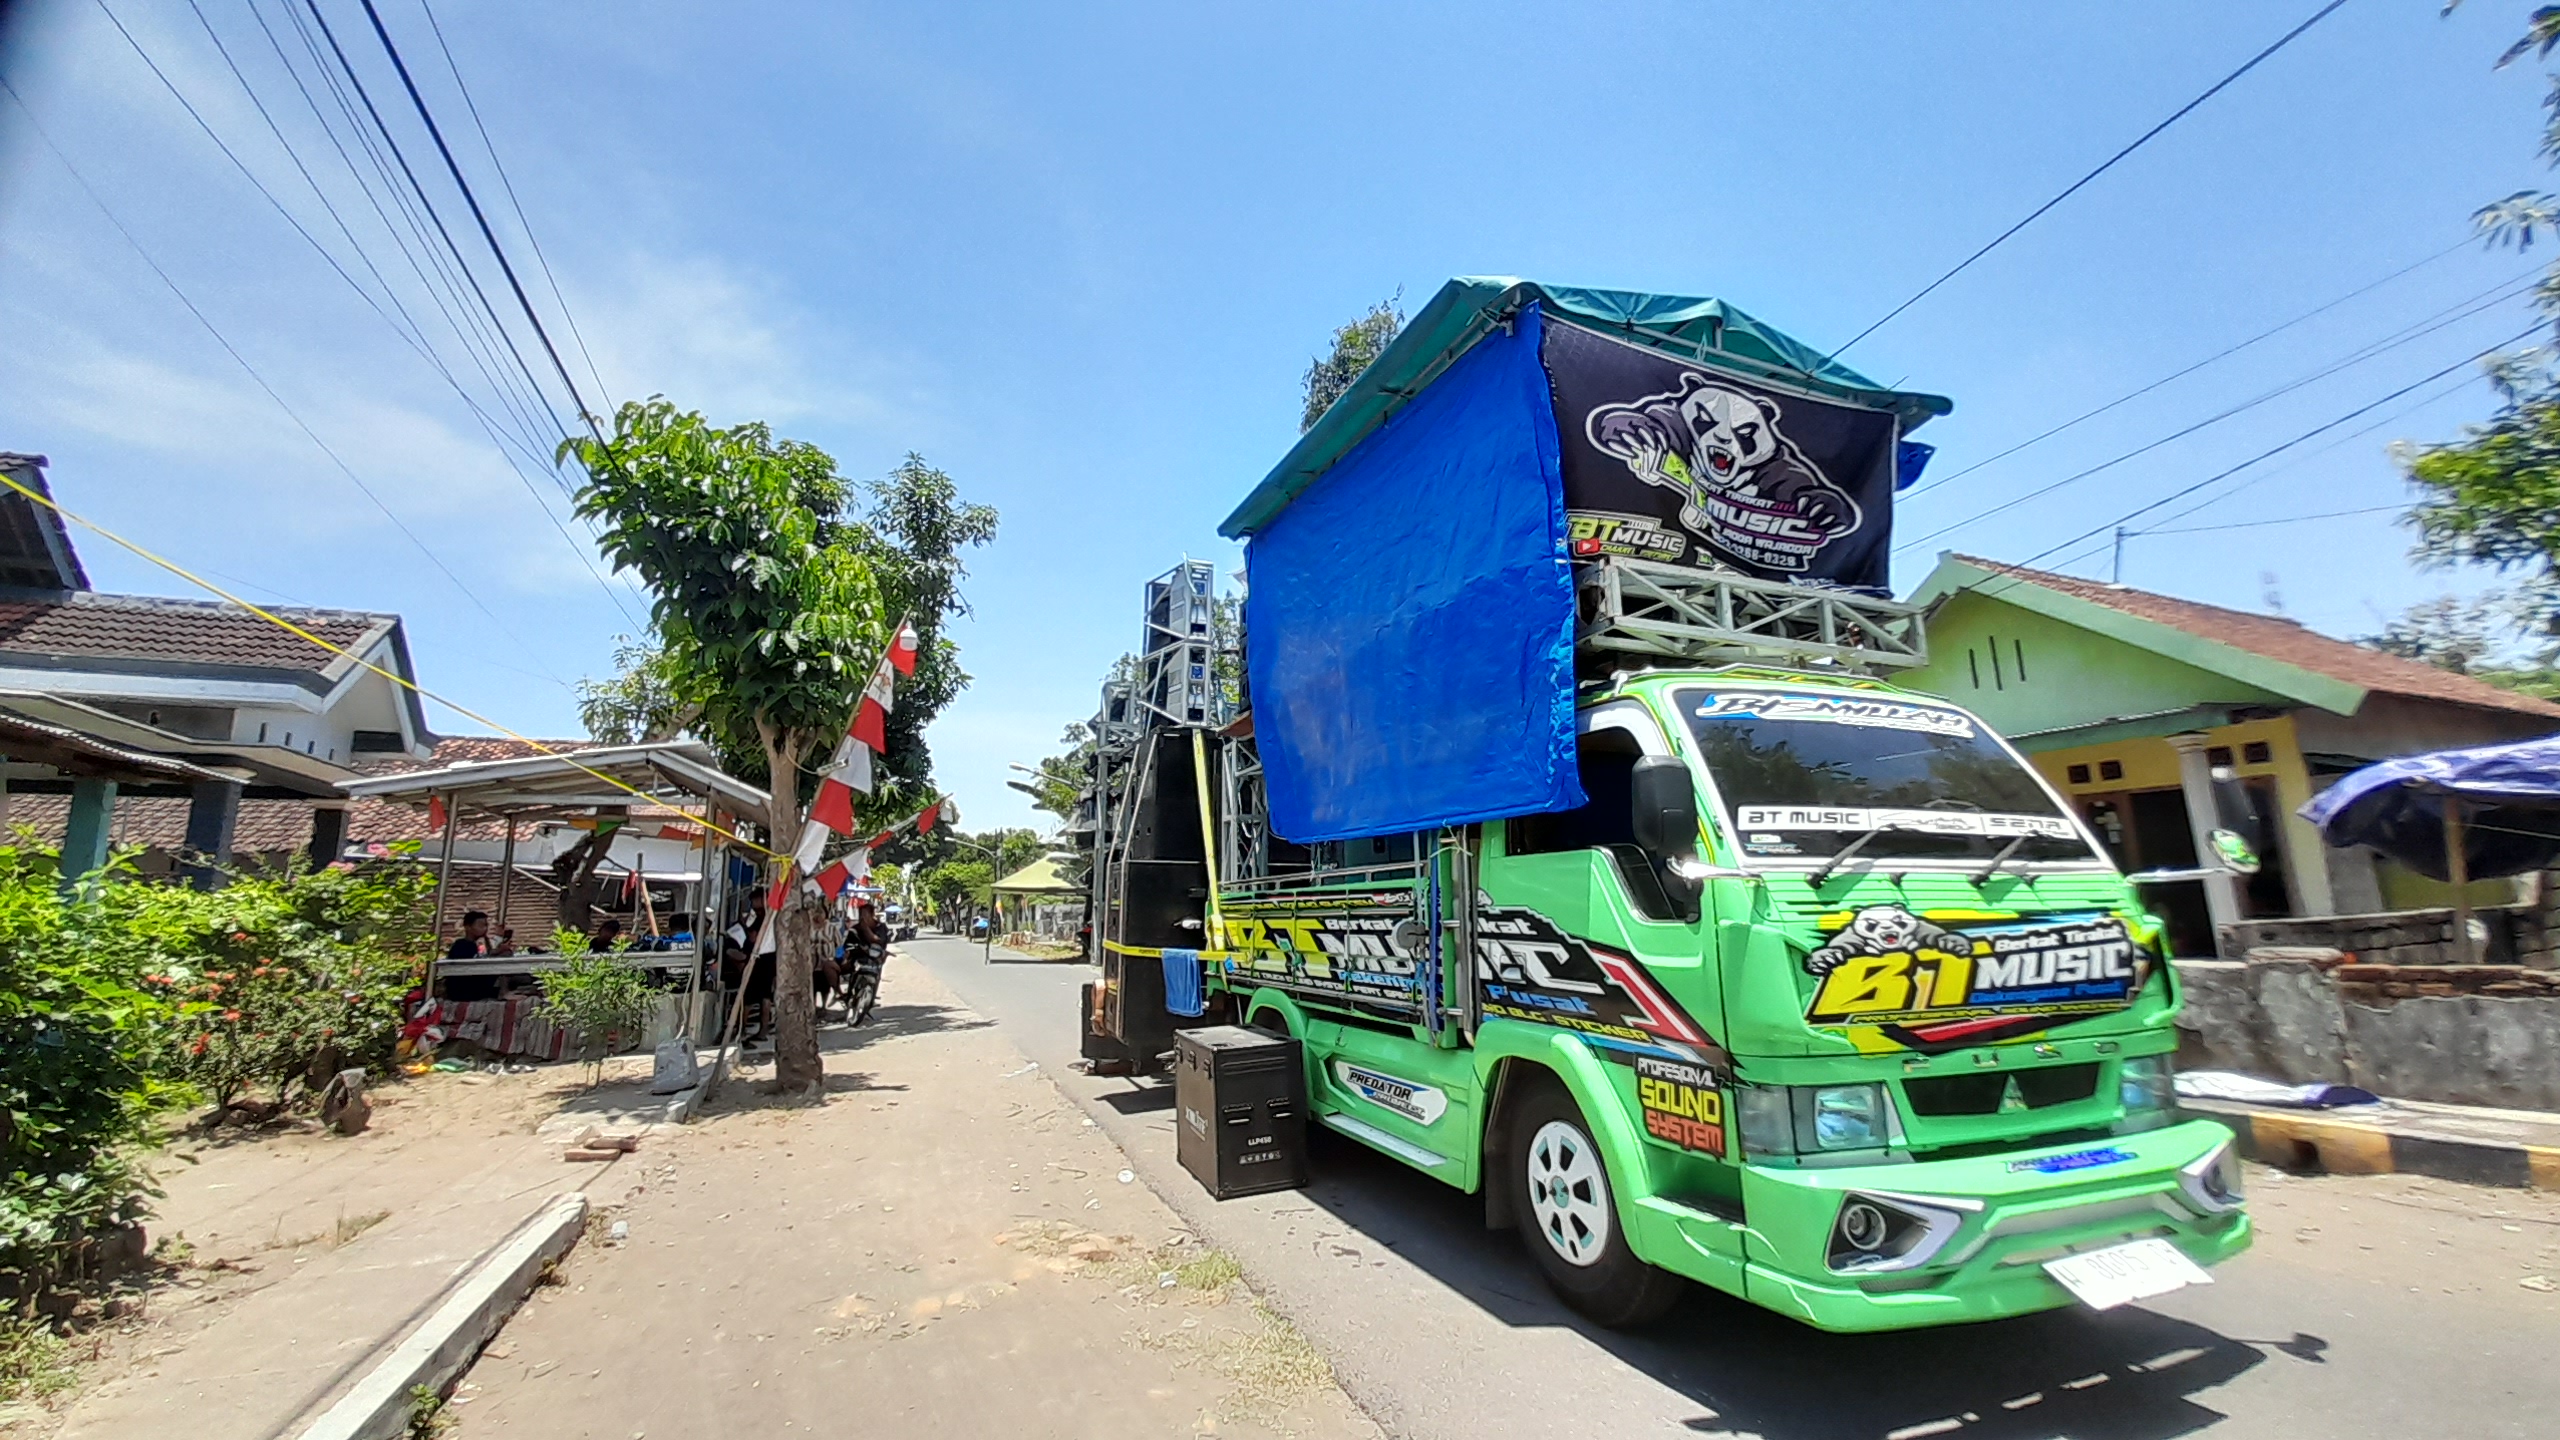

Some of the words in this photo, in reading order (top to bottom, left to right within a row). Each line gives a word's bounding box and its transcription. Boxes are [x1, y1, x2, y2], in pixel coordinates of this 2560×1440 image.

[1706, 497, 1822, 541] MUSIC
[1610, 527, 1683, 553] MUSIC
[1748, 811, 1782, 824] BT
[1790, 811, 1860, 825] MUSIC
[1324, 918, 1395, 931] Berkat
[1975, 942, 2133, 989] MUSIC
[1485, 984, 1598, 1016] Pusat
[1552, 1014, 1653, 1042] STICKER
[1350, 1072, 1412, 1100] PREDATOR
[1641, 1076, 1720, 1124] SOUND
[1646, 1108, 1723, 1154] SYSTEM
